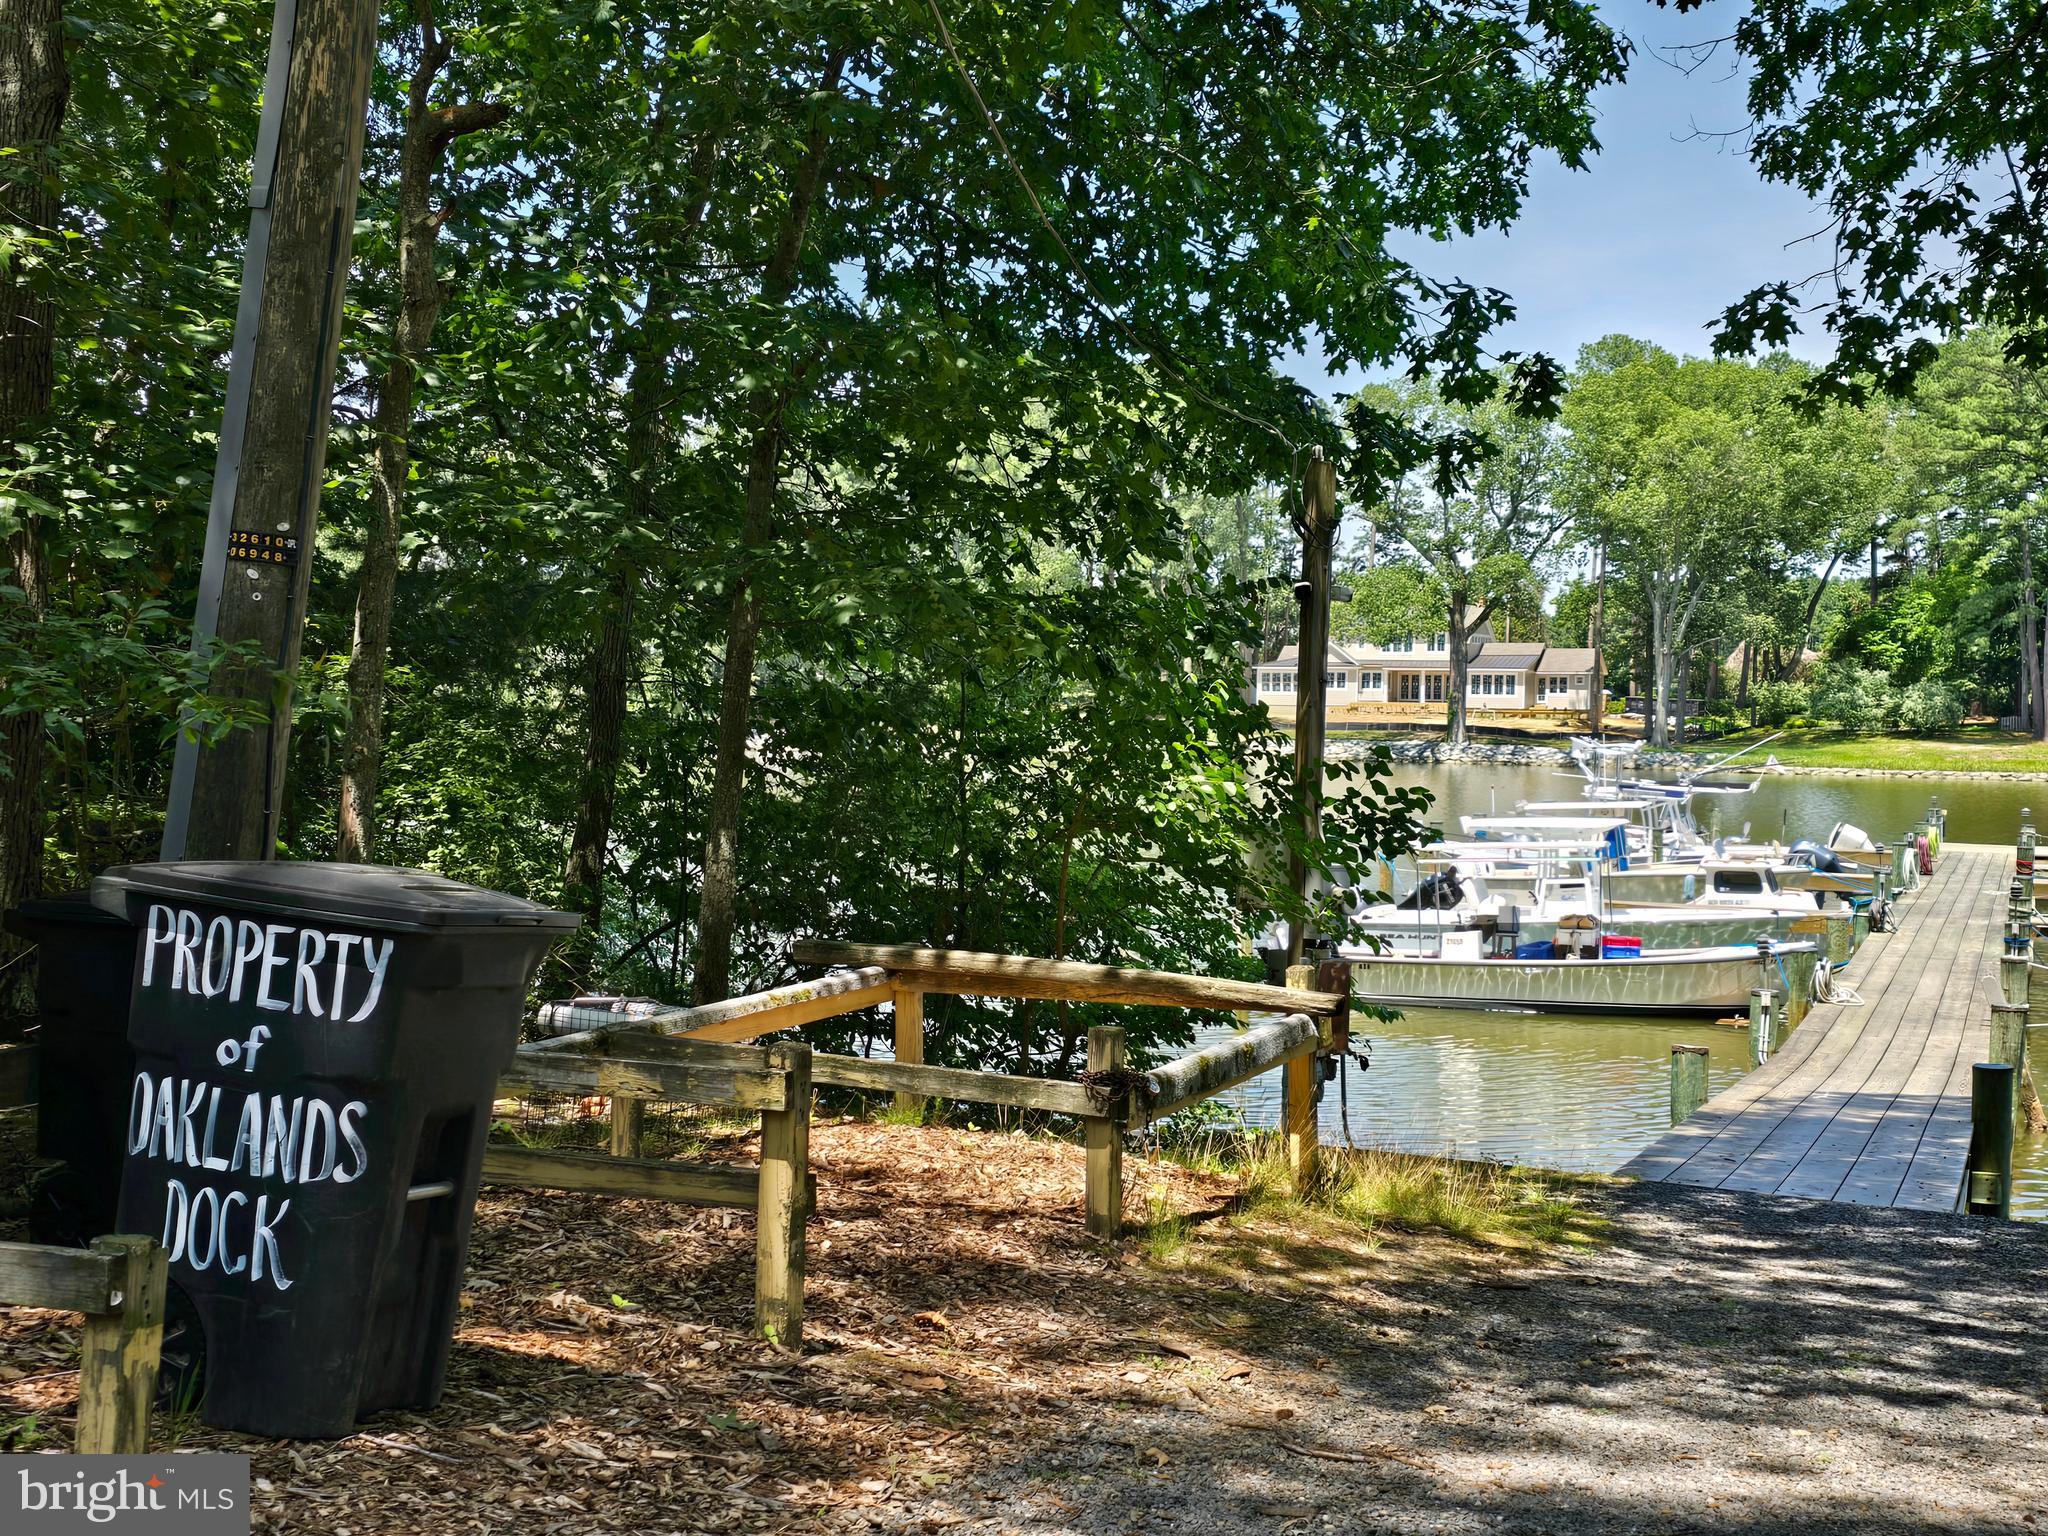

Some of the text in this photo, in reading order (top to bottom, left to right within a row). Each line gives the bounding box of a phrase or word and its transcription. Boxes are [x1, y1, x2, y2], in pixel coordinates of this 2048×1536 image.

[231, 532, 284, 547] 32610
[141, 904, 394, 1023] PROPERTY
[216, 1025, 272, 1073] of
[128, 1071, 368, 1184] OAKLANDS
[161, 1178, 294, 1291] DOCK
